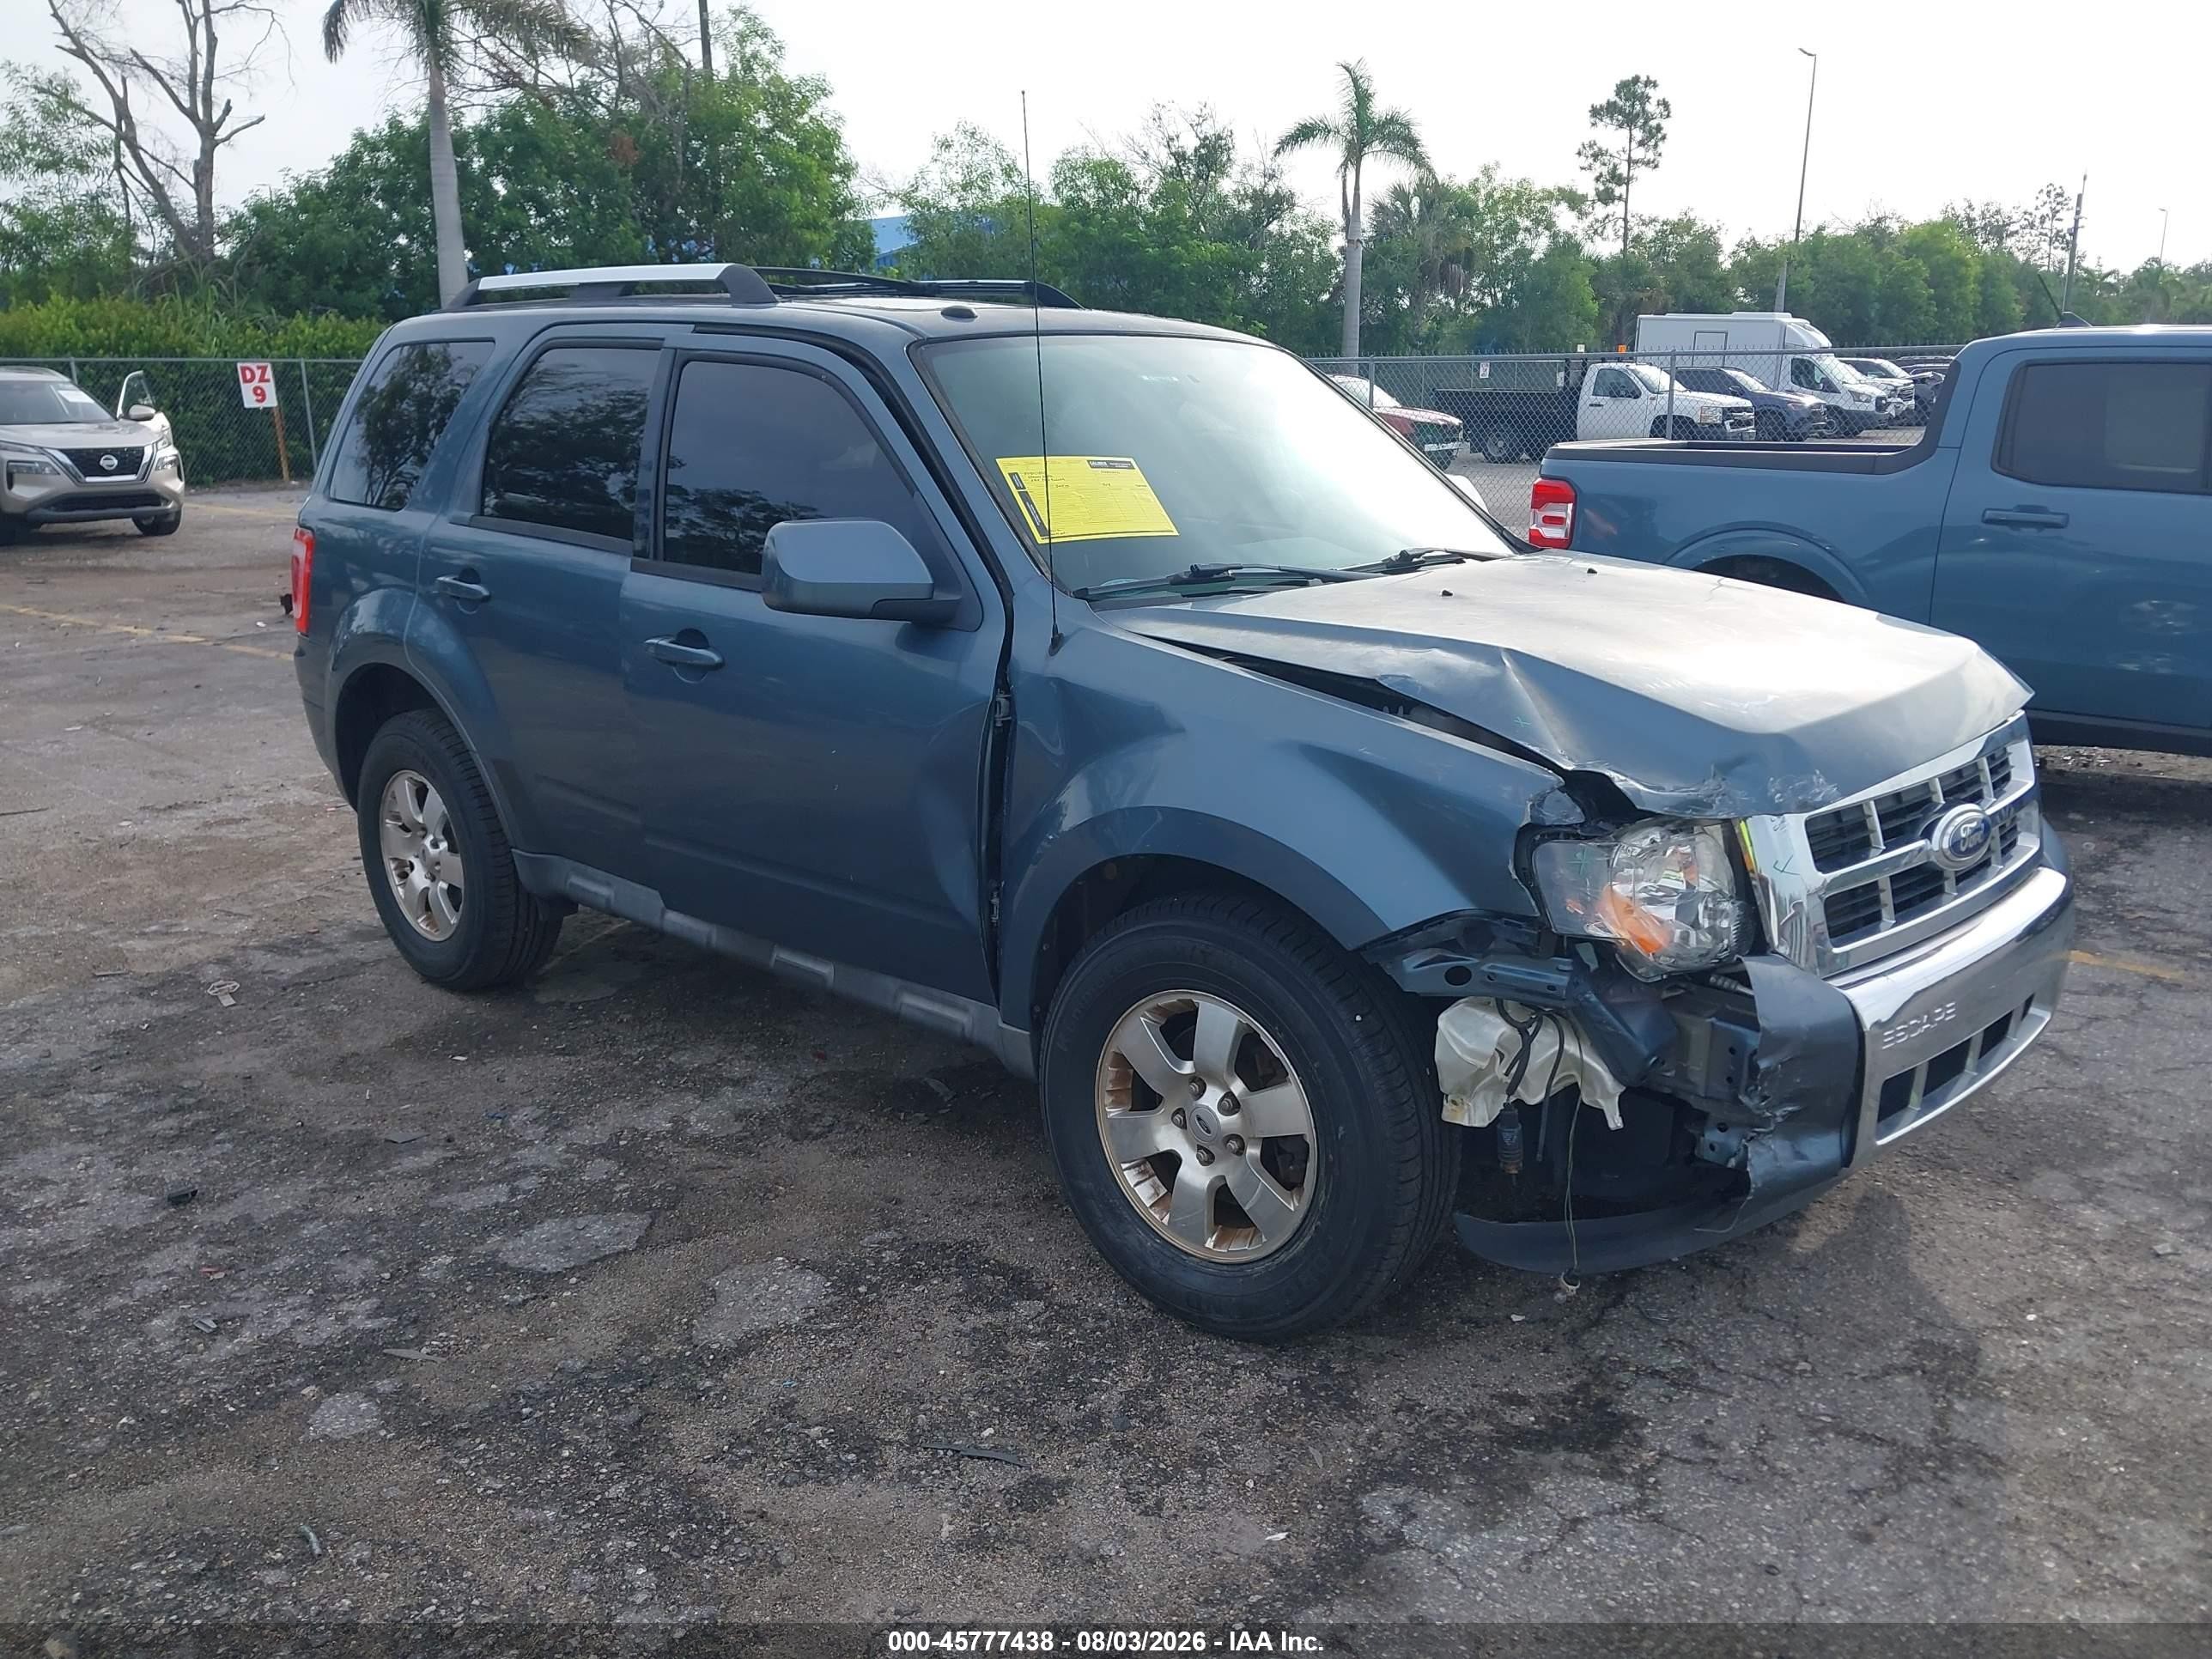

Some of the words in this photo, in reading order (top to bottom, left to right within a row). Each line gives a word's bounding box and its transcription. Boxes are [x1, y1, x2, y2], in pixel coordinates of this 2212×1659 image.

[240, 365, 270, 384] DZ
[252, 386, 267, 404] 9
[1960, 819, 1985, 852] Ford
[1881, 1001, 1956, 1049] ESCAPE
